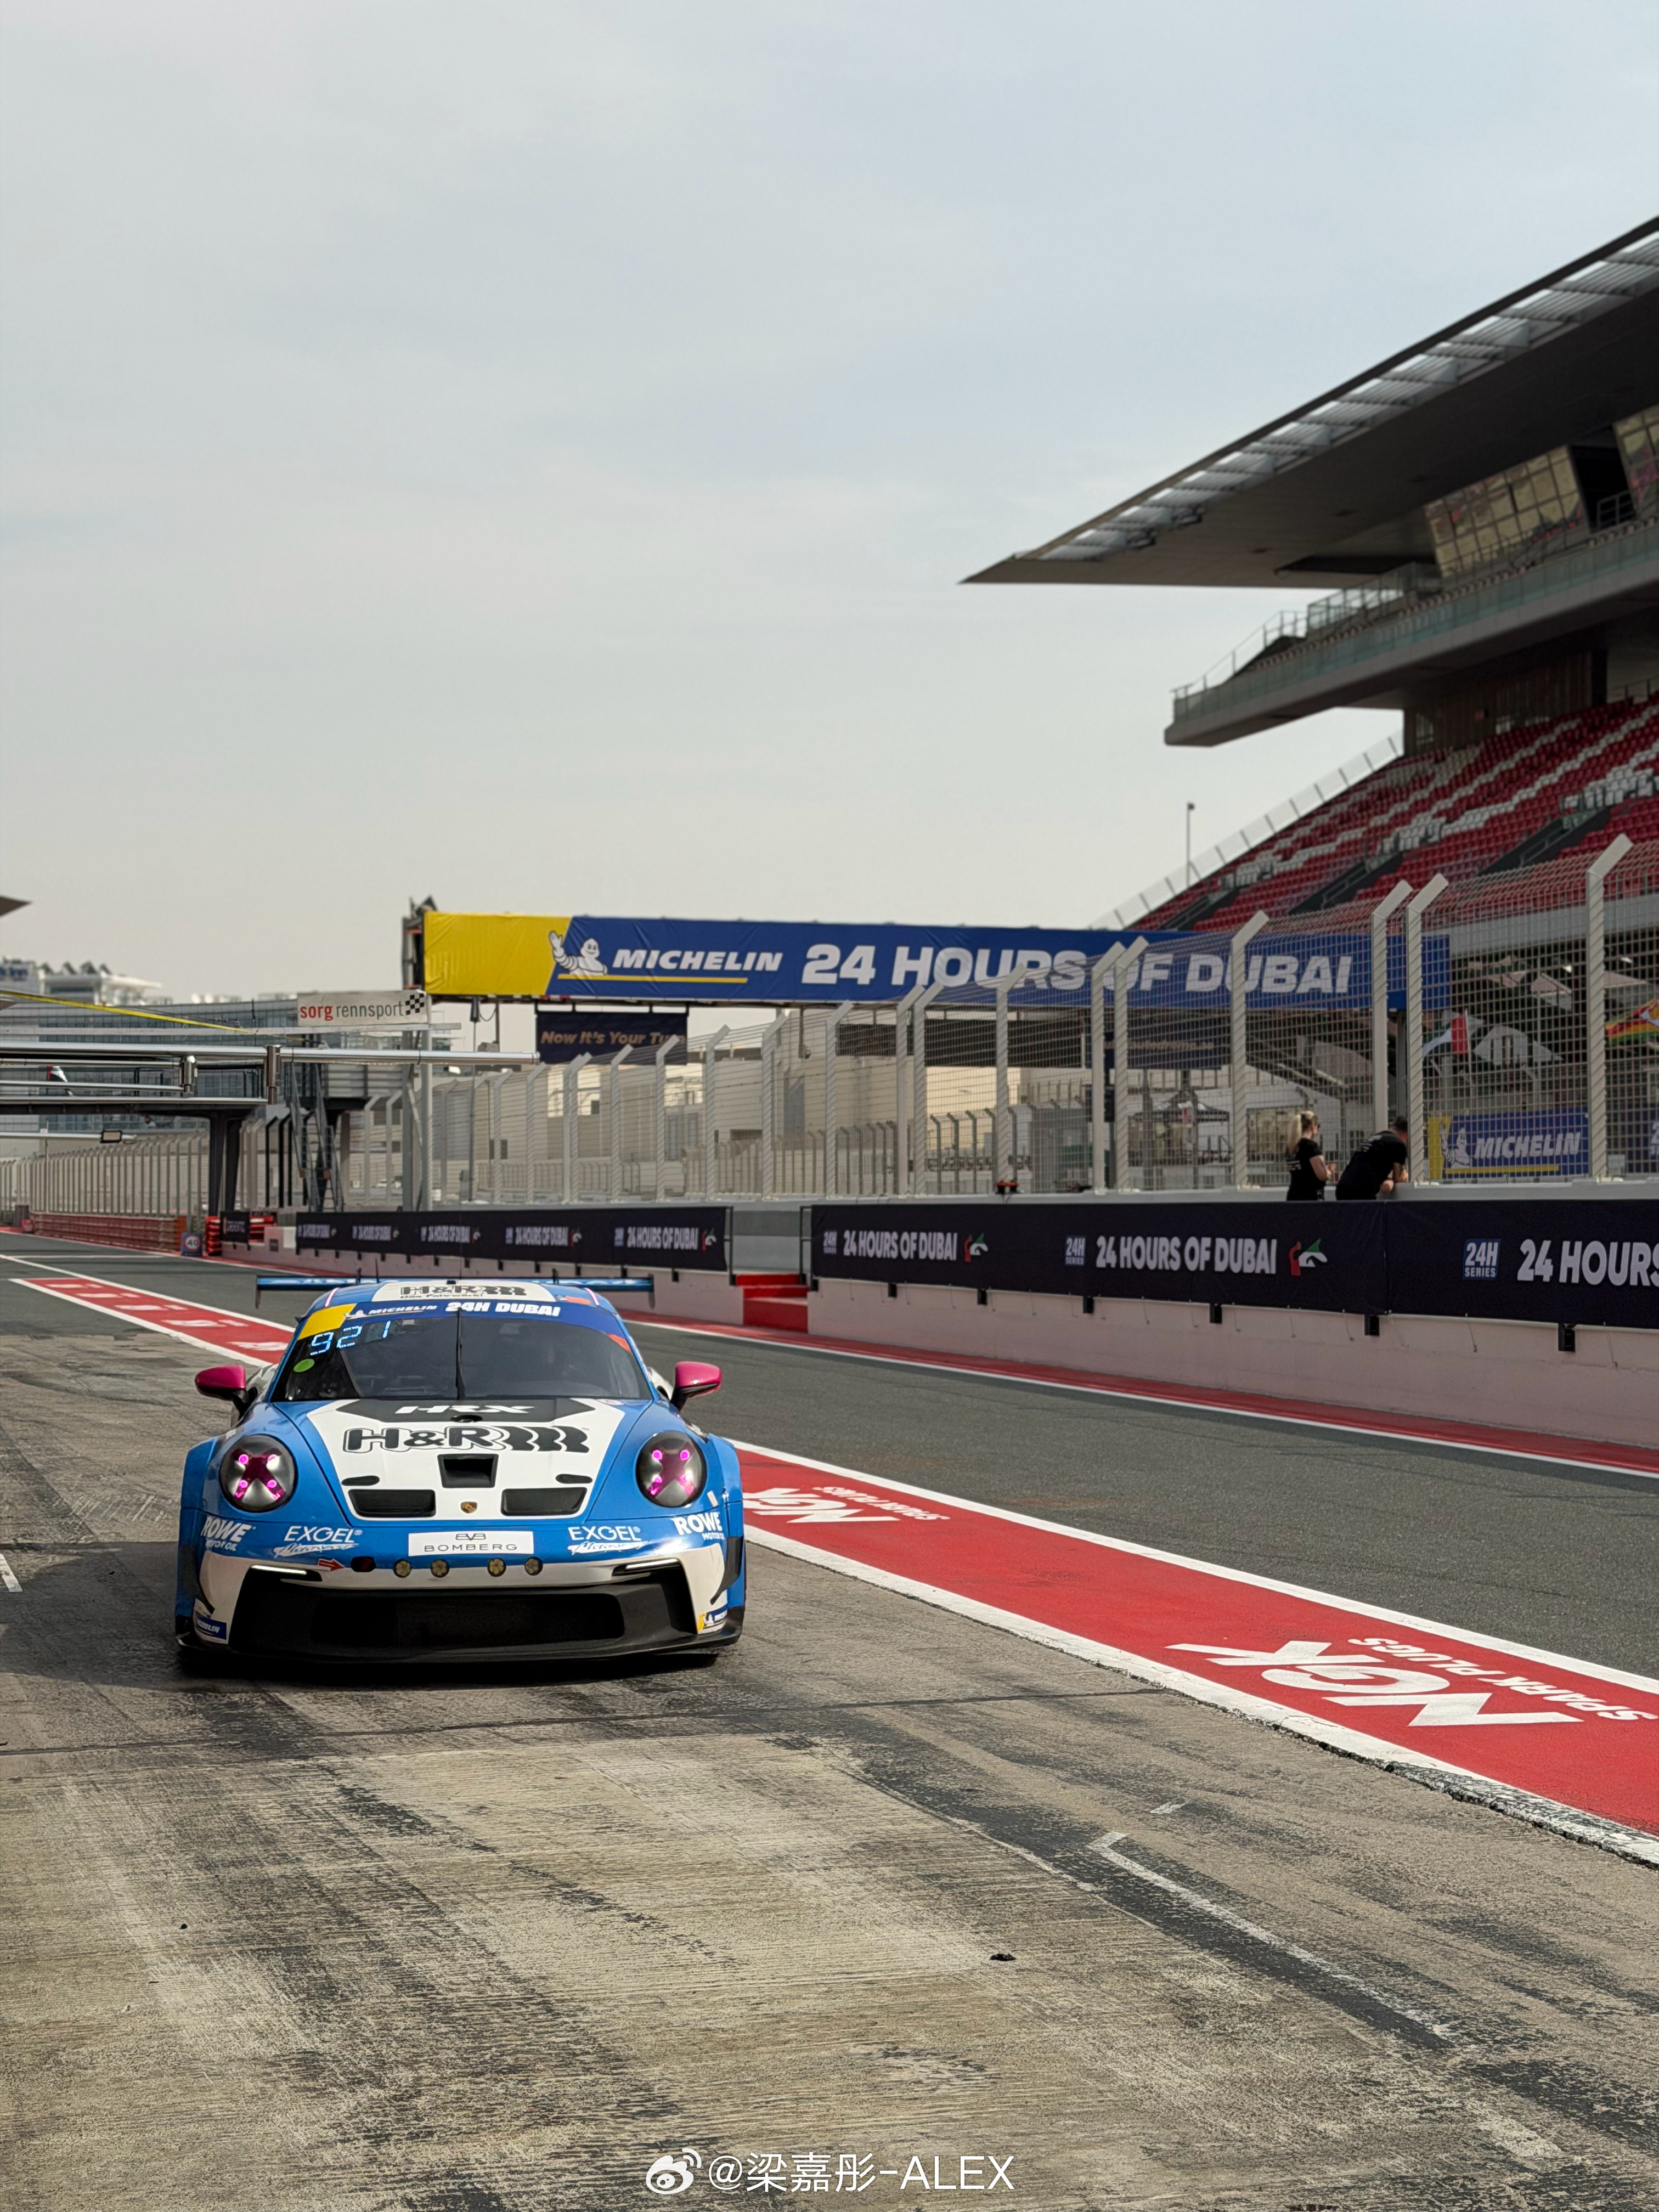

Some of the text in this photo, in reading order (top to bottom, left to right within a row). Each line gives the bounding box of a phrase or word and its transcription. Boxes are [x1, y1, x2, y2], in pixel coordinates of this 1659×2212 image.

[613, 949, 783, 972] MICHELIN
[802, 944, 876, 985] 24
[891, 946, 1087, 990] HOURS
[1185, 954, 1352, 994] DUBAI
[300, 1001, 403, 1021] sorg rennsport
[540, 1031, 685, 1045] Now It's Your Tun
[1474, 1132, 1581, 1160] MICHELIN
[187, 1238, 199, 1246] 40
[627, 1227, 698, 1250] 24 HOURS OF DUBAI
[823, 1231, 837, 1247] 24H
[843, 1229, 958, 1261] 24 HOURS OF DUBAI
[1065, 1237, 1086, 1257] 24H
[1065, 1257, 1084, 1265] SERIES
[1096, 1235, 1277, 1274] 24 HOURS OF DUBAI
[1465, 1242, 1499, 1266] 24H
[1517, 1239, 1554, 1282] 24
[1464, 1267, 1496, 1278] SERIES
[369, 1305, 438, 1314] MICHELIN
[445, 1302, 561, 1317] 24H DUBAI
[200, 1516, 252, 1543] ROWE
[568, 1526, 642, 1541] EXGEL
[673, 1511, 723, 1536] ROWE
[284, 1526, 355, 1543] EXGEL
[424, 1544, 517, 1553] BOMBERG
[1164, 1640, 1585, 1726] NGK
[1348, 1638, 1658, 1721] SPARK PLUGS
